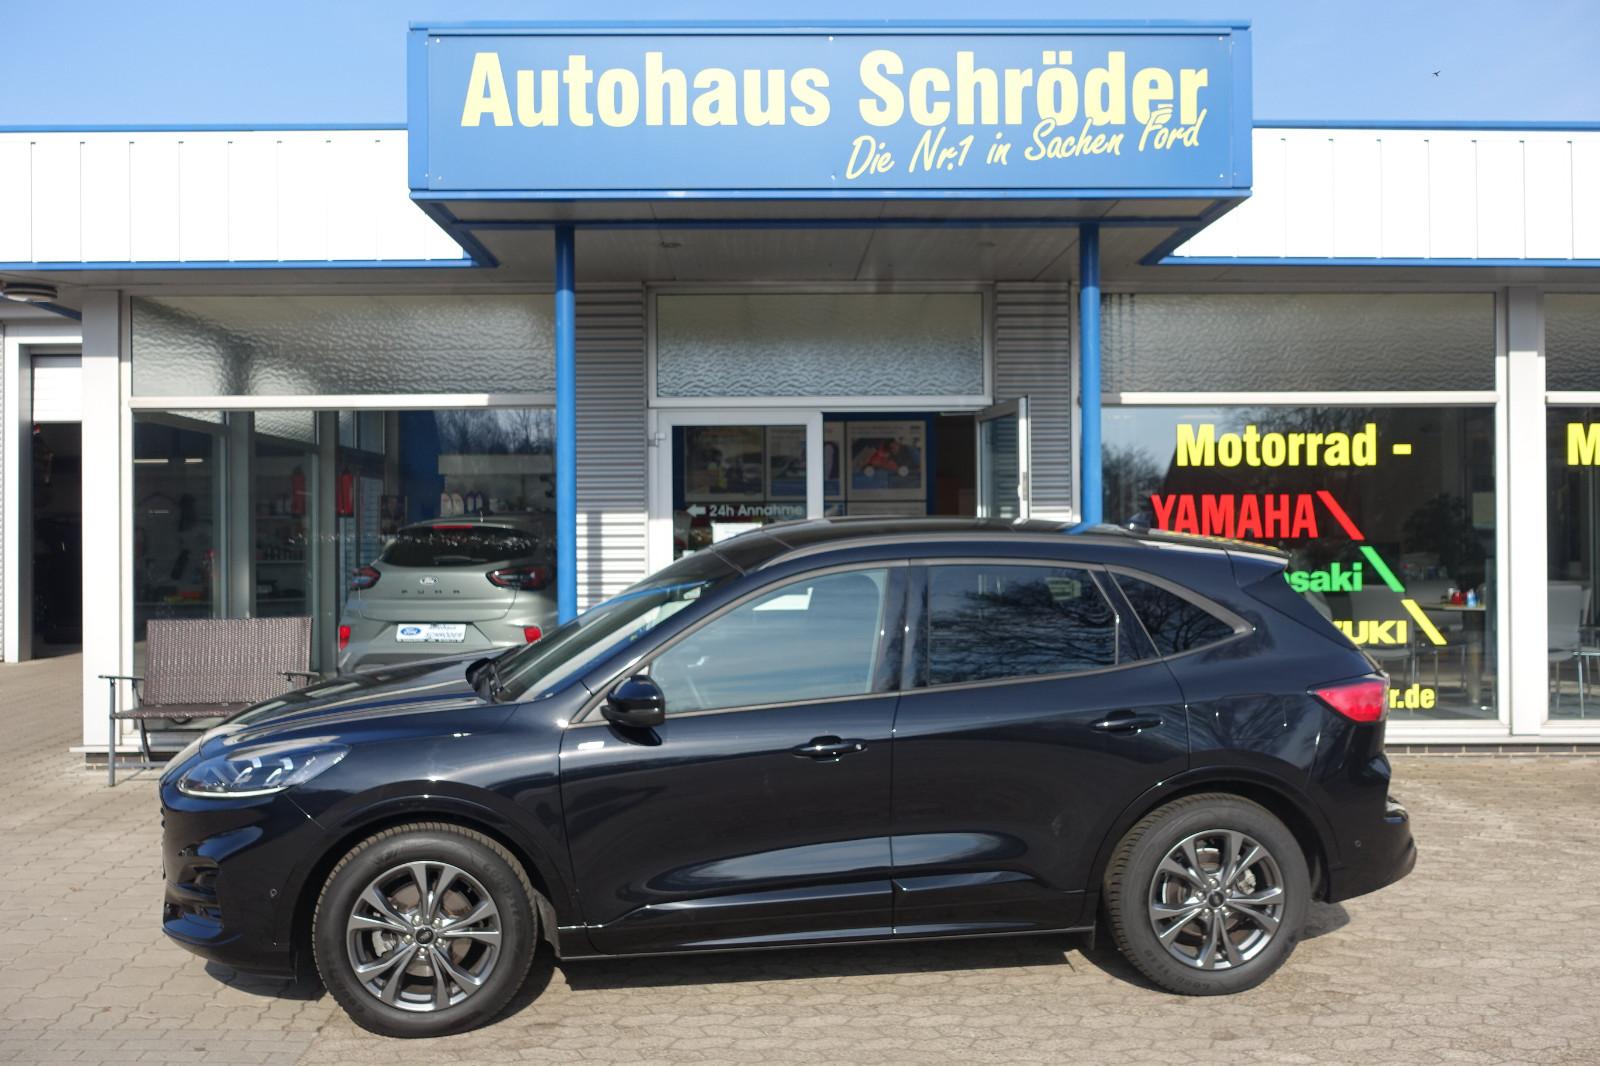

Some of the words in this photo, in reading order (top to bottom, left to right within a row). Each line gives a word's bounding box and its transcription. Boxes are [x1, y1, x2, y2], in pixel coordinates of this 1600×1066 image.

[461, 51, 831, 127] Autohaus
[859, 49, 1209, 127] Schröder
[845, 134, 896, 180] Die
[908, 126, 975, 174] Nr.1
[986, 131, 1012, 166] in
[1024, 117, 1125, 161] Sachen
[1138, 107, 1208, 152] Ford
[1176, 422, 1377, 467] Motorrad
[709, 503, 735, 517] 24h
[738, 502, 804, 516] Annahme
[1151, 493, 1319, 539] YAMAHA
[1284, 562, 1363, 593] saki
